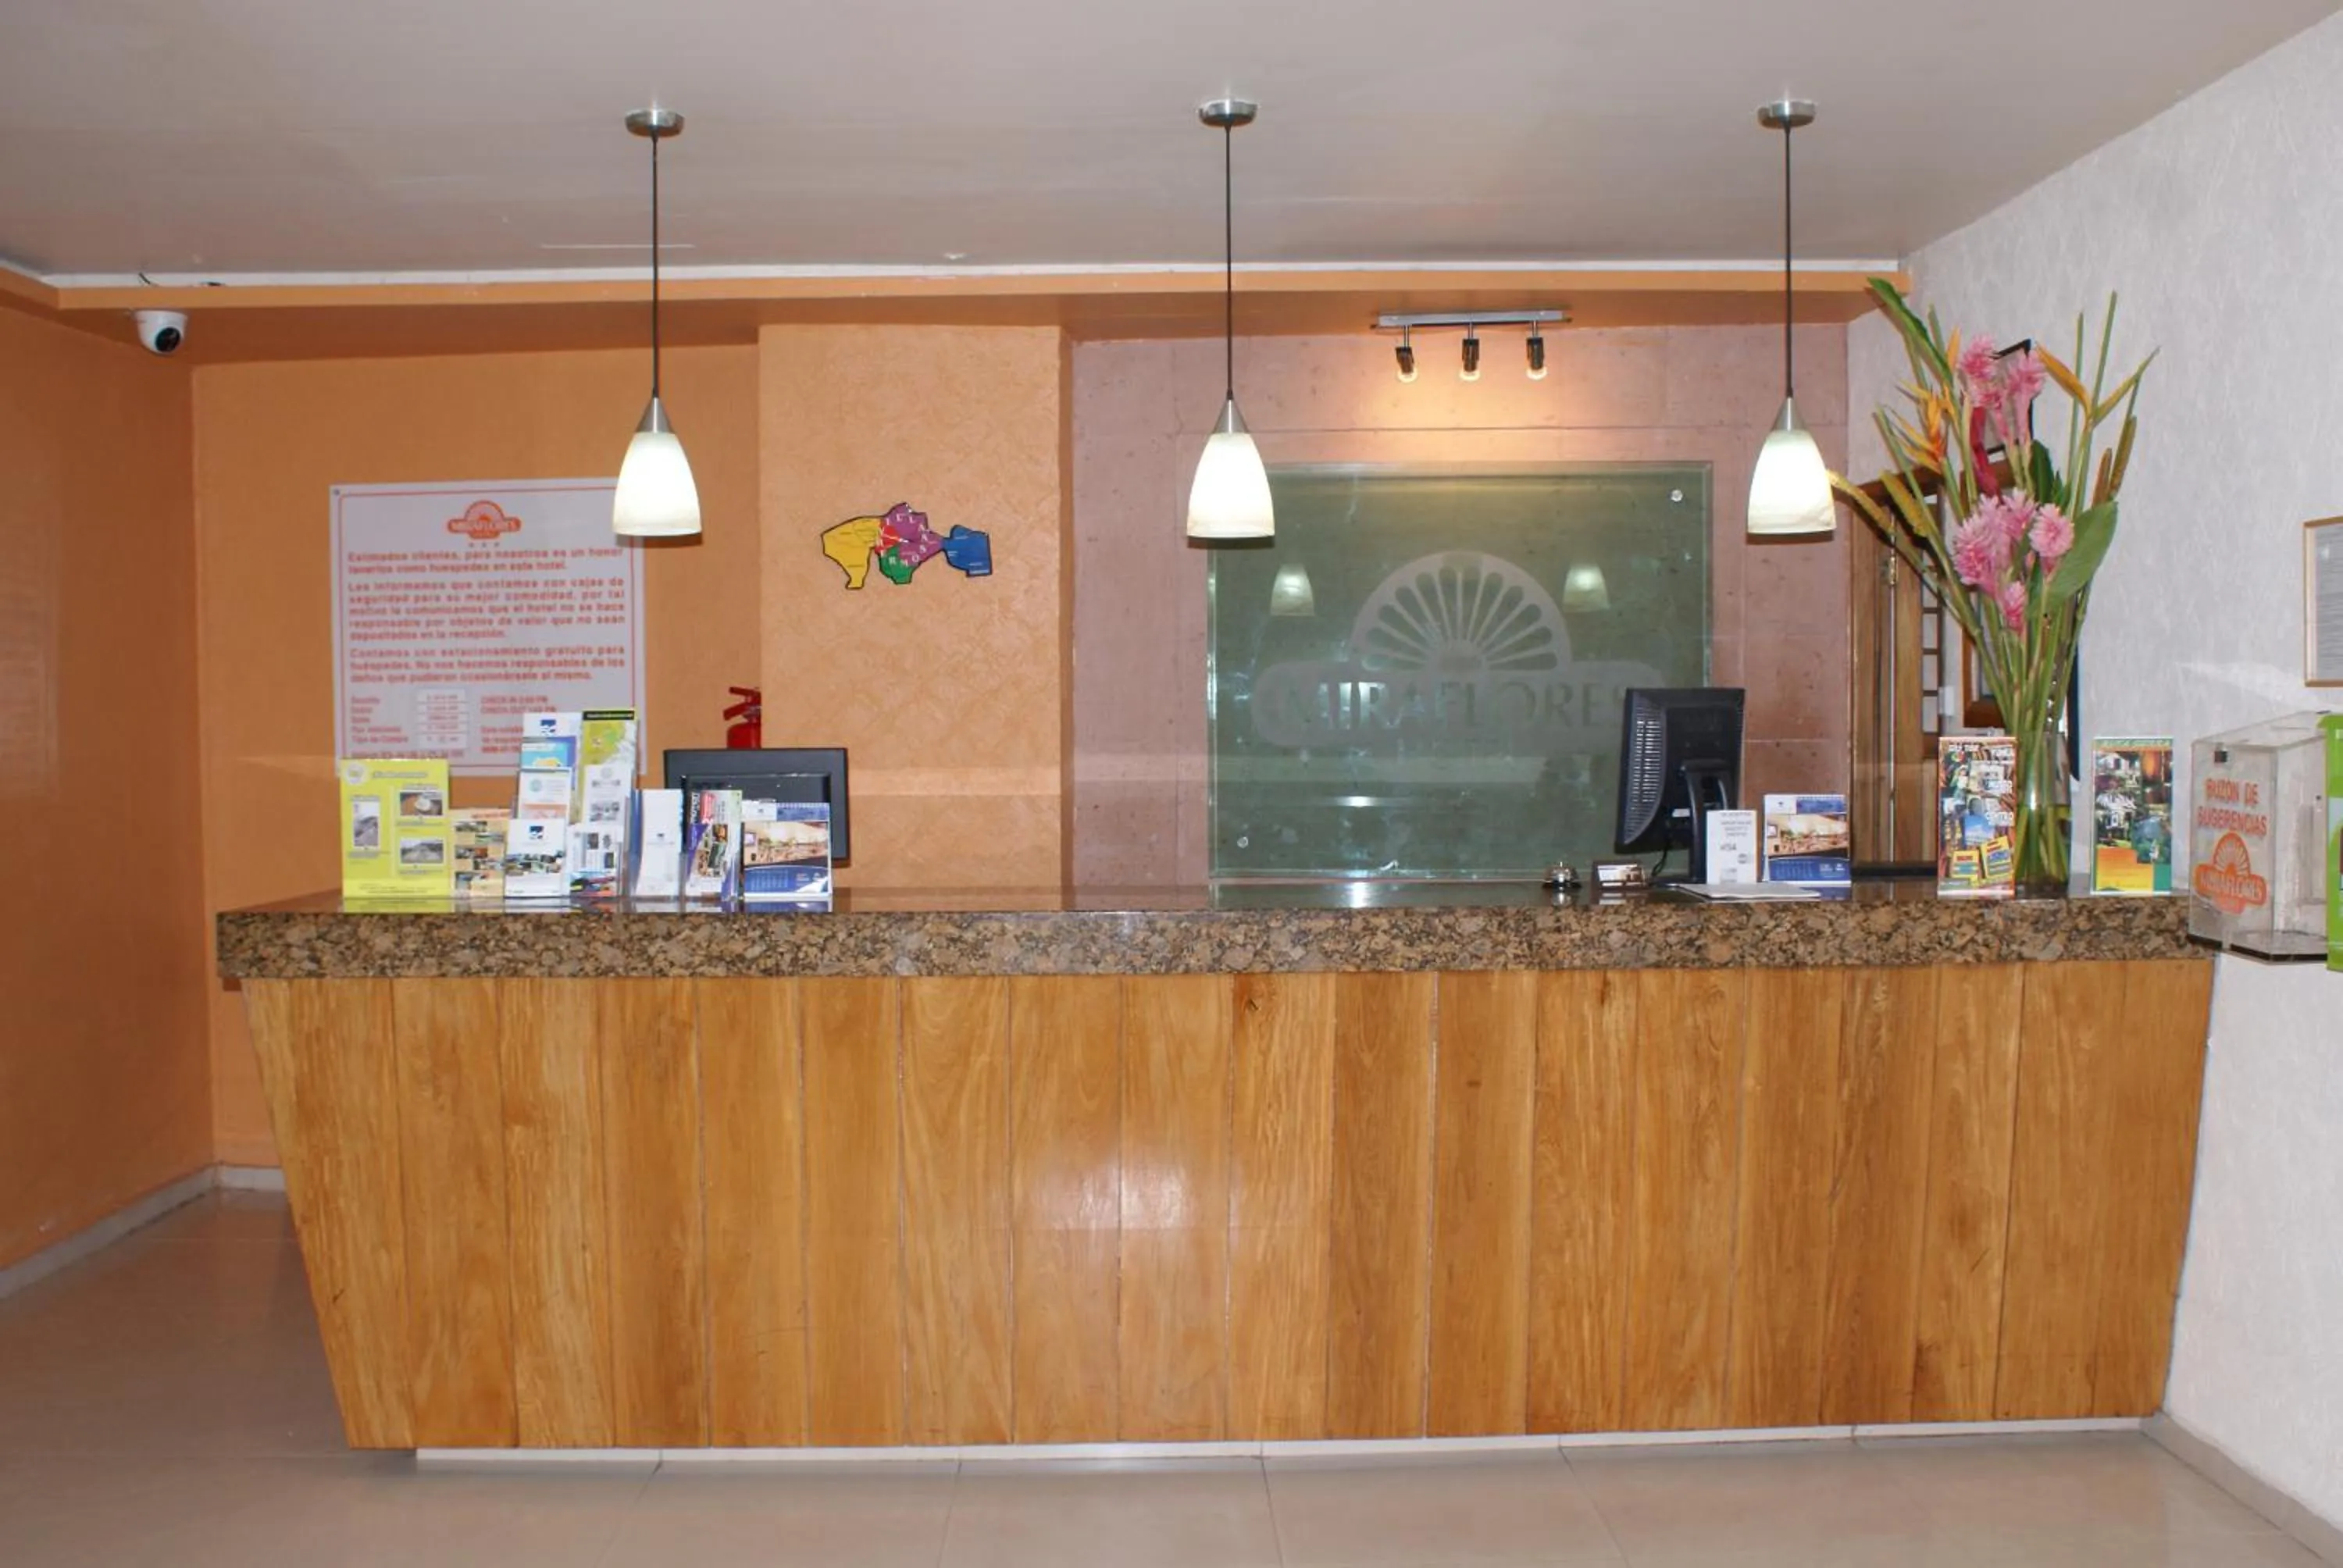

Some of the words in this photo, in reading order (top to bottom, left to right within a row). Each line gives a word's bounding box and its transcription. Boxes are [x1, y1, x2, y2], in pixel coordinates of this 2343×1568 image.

[465, 551, 490, 561] para
[495, 550, 548, 558] nosotros
[571, 549, 585, 558] un
[589, 547, 623, 557] honor
[374, 581, 445, 590] informamos
[451, 581, 473, 590] que
[478, 579, 538, 589] contamos
[544, 579, 565, 588] con
[571, 578, 604, 590] cajas
[609, 577, 624, 586] de
[350, 593, 409, 605] seguridad
[414, 594, 441, 604] para
[465, 593, 500, 604] mejor
[582, 590, 602, 600] por
[608, 589, 624, 597] tal
[489, 604, 508, 614] que
[513, 604, 524, 612] el
[527, 603, 557, 612] hotel
[597, 602, 624, 611] hace
[450, 616, 494, 628] objetos
[497, 616, 512, 625] de
[517, 616, 547, 625] valor
[551, 617, 572, 627] que
[597, 615, 625, 624] sean
[350, 648, 410, 657] Contamos
[440, 647, 540, 657] estacionamiento
[545, 646, 593, 657] gratuito
[597, 646, 625, 656] para
[458, 659, 508, 668] hacemos
[511, 659, 587, 671] responsables
[590, 658, 604, 667] de
[608, 658, 625, 667] los
[2245, 782, 2259, 805] DE
[2197, 805, 2267, 838] SUGERENCIAS
